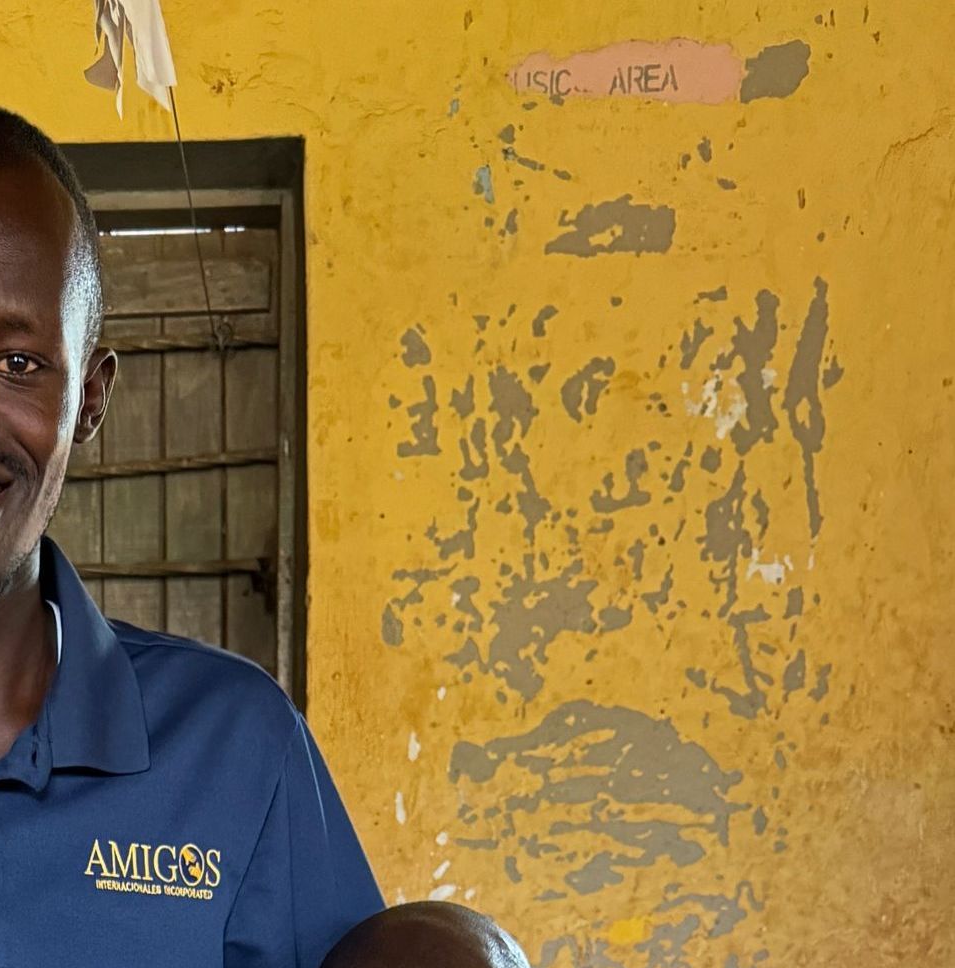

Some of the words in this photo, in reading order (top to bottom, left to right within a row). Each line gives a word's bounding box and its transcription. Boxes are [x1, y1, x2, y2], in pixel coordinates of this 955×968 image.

[511, 68, 572, 97] USIC
[608, 63, 680, 96] AREA
[84, 838, 221, 887] AMIGOS
[163, 886, 213, 900] INCORPORATED
